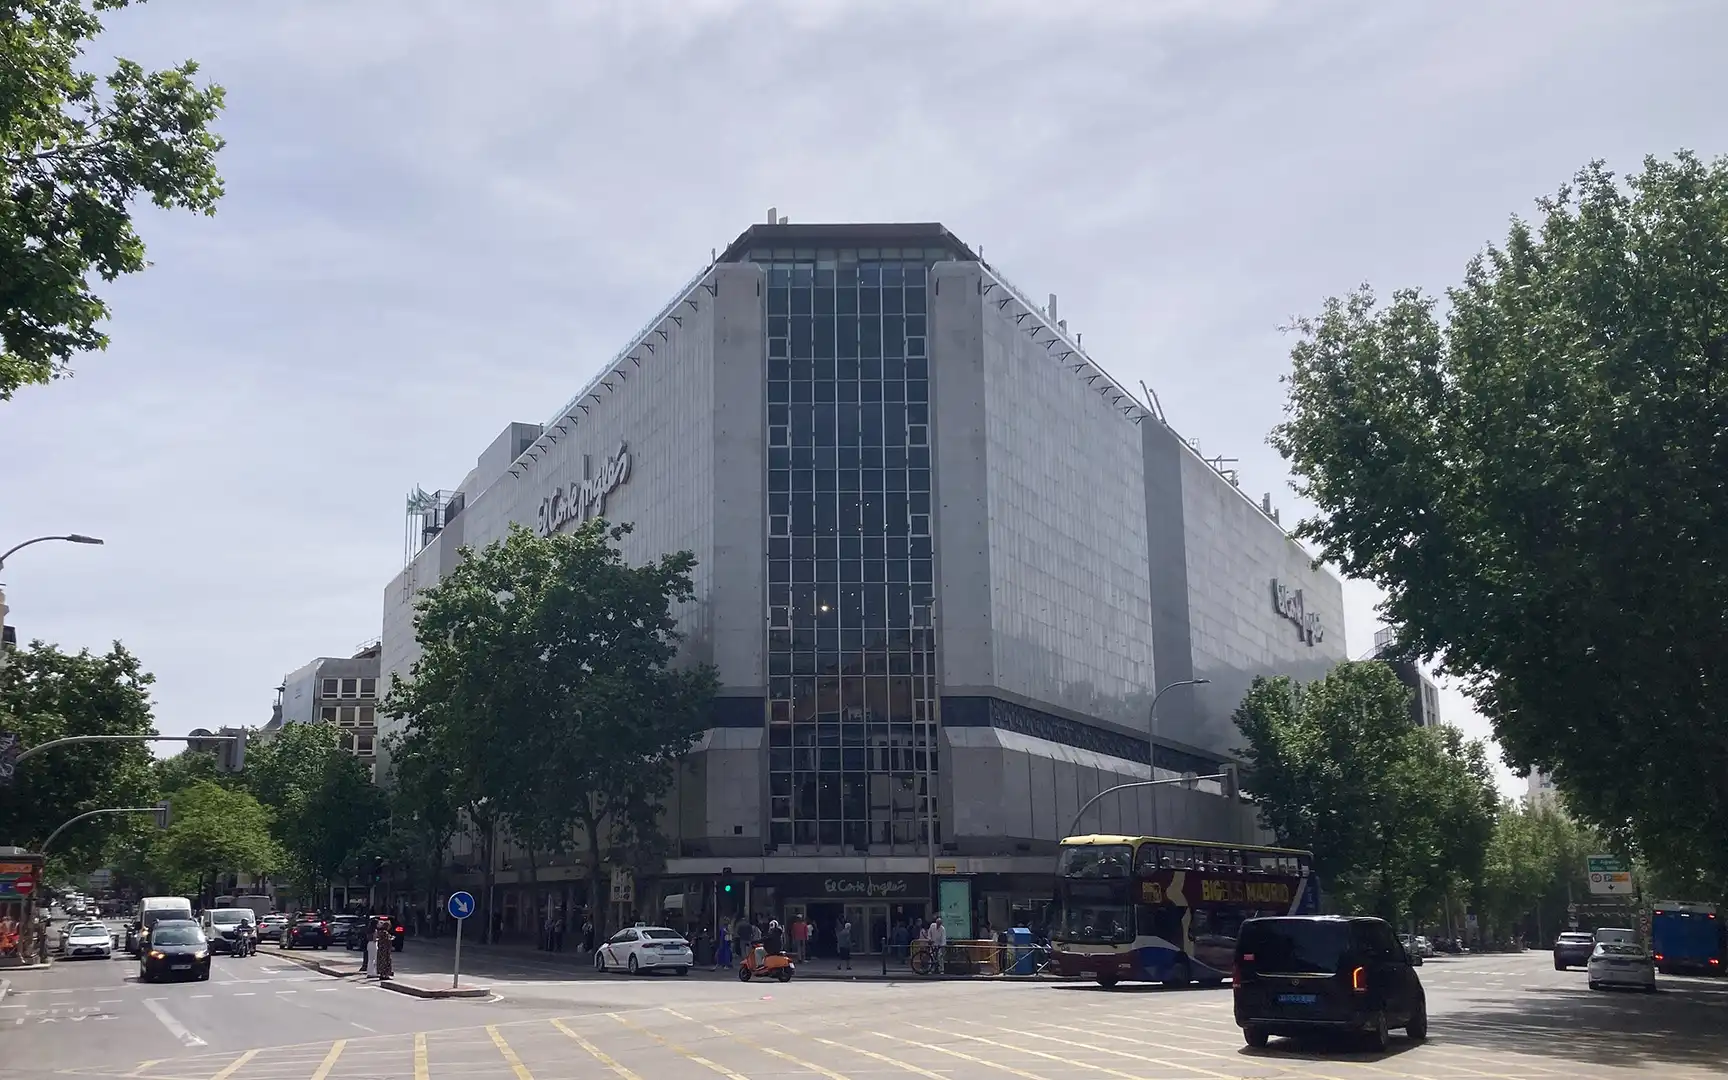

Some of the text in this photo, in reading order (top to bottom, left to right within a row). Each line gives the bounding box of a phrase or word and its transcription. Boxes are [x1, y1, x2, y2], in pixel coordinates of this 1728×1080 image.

[824, 878, 837, 893] El
[837, 879, 866, 893] Corte
[1245, 882, 1289, 903] MADRID
